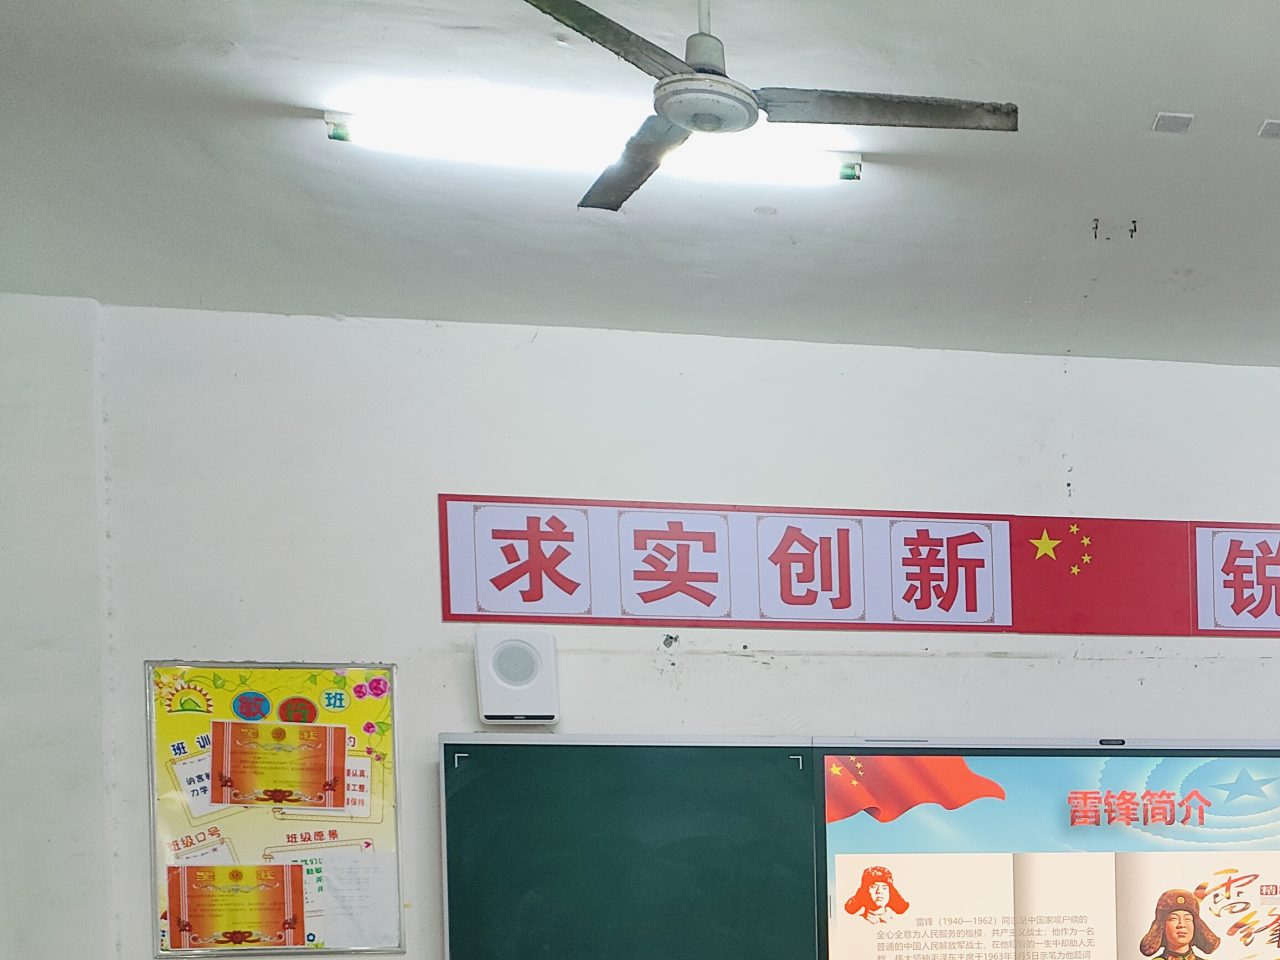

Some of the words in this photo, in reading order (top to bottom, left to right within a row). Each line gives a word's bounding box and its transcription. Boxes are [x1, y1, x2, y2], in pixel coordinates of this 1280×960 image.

[489, 515, 986, 614] 求实创新
[1068, 789, 1212, 827] 雷锋简介
[169, 826, 221, 852] 班级口号
[286, 829, 339, 844] 班级愿景
